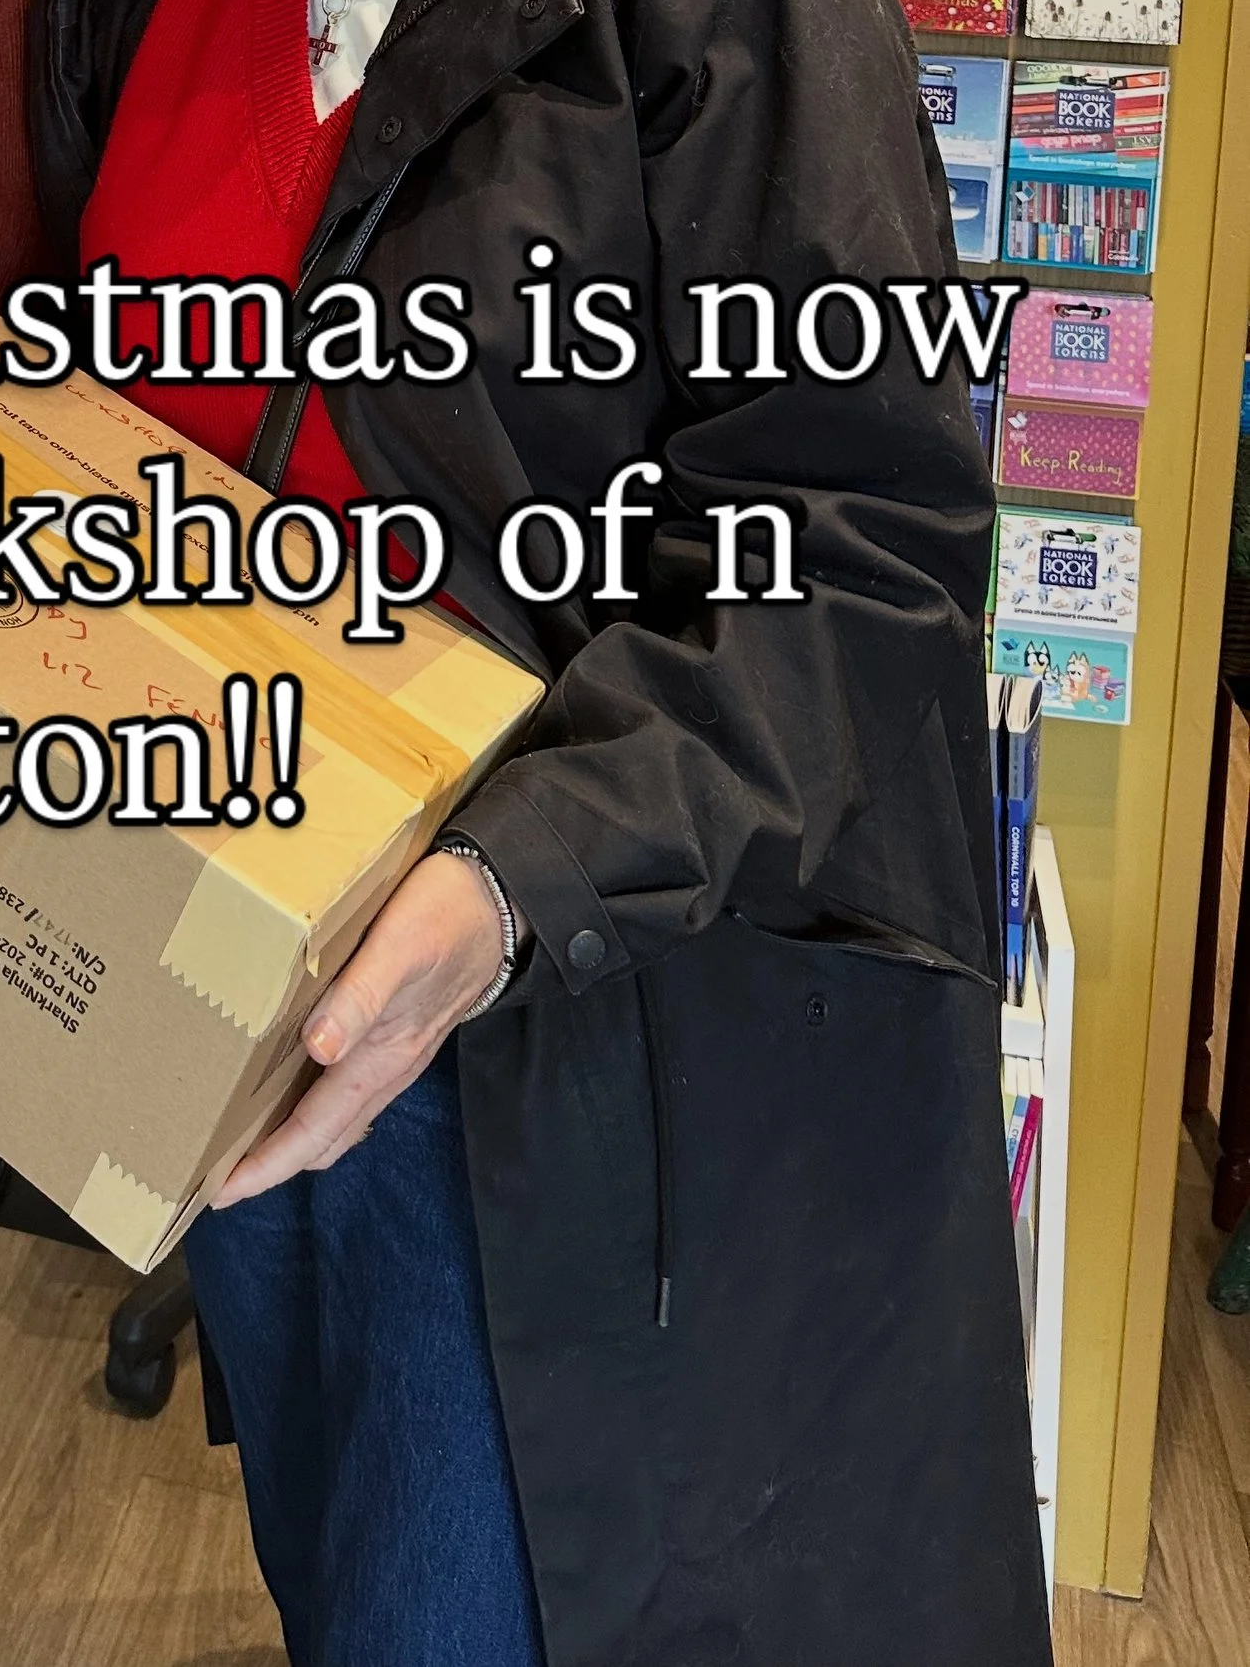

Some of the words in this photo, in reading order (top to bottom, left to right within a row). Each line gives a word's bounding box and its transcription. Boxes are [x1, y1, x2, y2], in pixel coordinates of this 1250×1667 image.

[1059, 92, 1112, 103] NATIONAL
[1058, 101, 1112, 118] BOOK
[1058, 116, 1112, 129] tokens
[1055, 324, 1106, 335] NATIONAL
[1055, 333, 1105, 351] BOOK
[1055, 347, 1106, 360] tokens
[18, 418, 49, 441] tape
[49, 440, 119, 491] only-blade
[119, 490, 152, 517] mus
[1020, 445, 1061, 475] Keep
[1067, 449, 1123, 484] Reading
[1043, 550, 1094, 561] NATIONAL
[1043, 558, 1094, 577] BOOK
[1042, 573, 1094, 587] tokens
[1011, 826, 1021, 880] CORNWALL
[1011, 880, 1020, 898] TOP
[25, 933, 47, 958] PC
[48, 951, 60, 966] 1
[71, 941, 106, 976] C/N:
[29, 961, 63, 998] PO#:
[63, 960, 98, 996] QTY:
[2, 964, 80, 1034] SharkNinja
[65, 994, 89, 1015] SN
